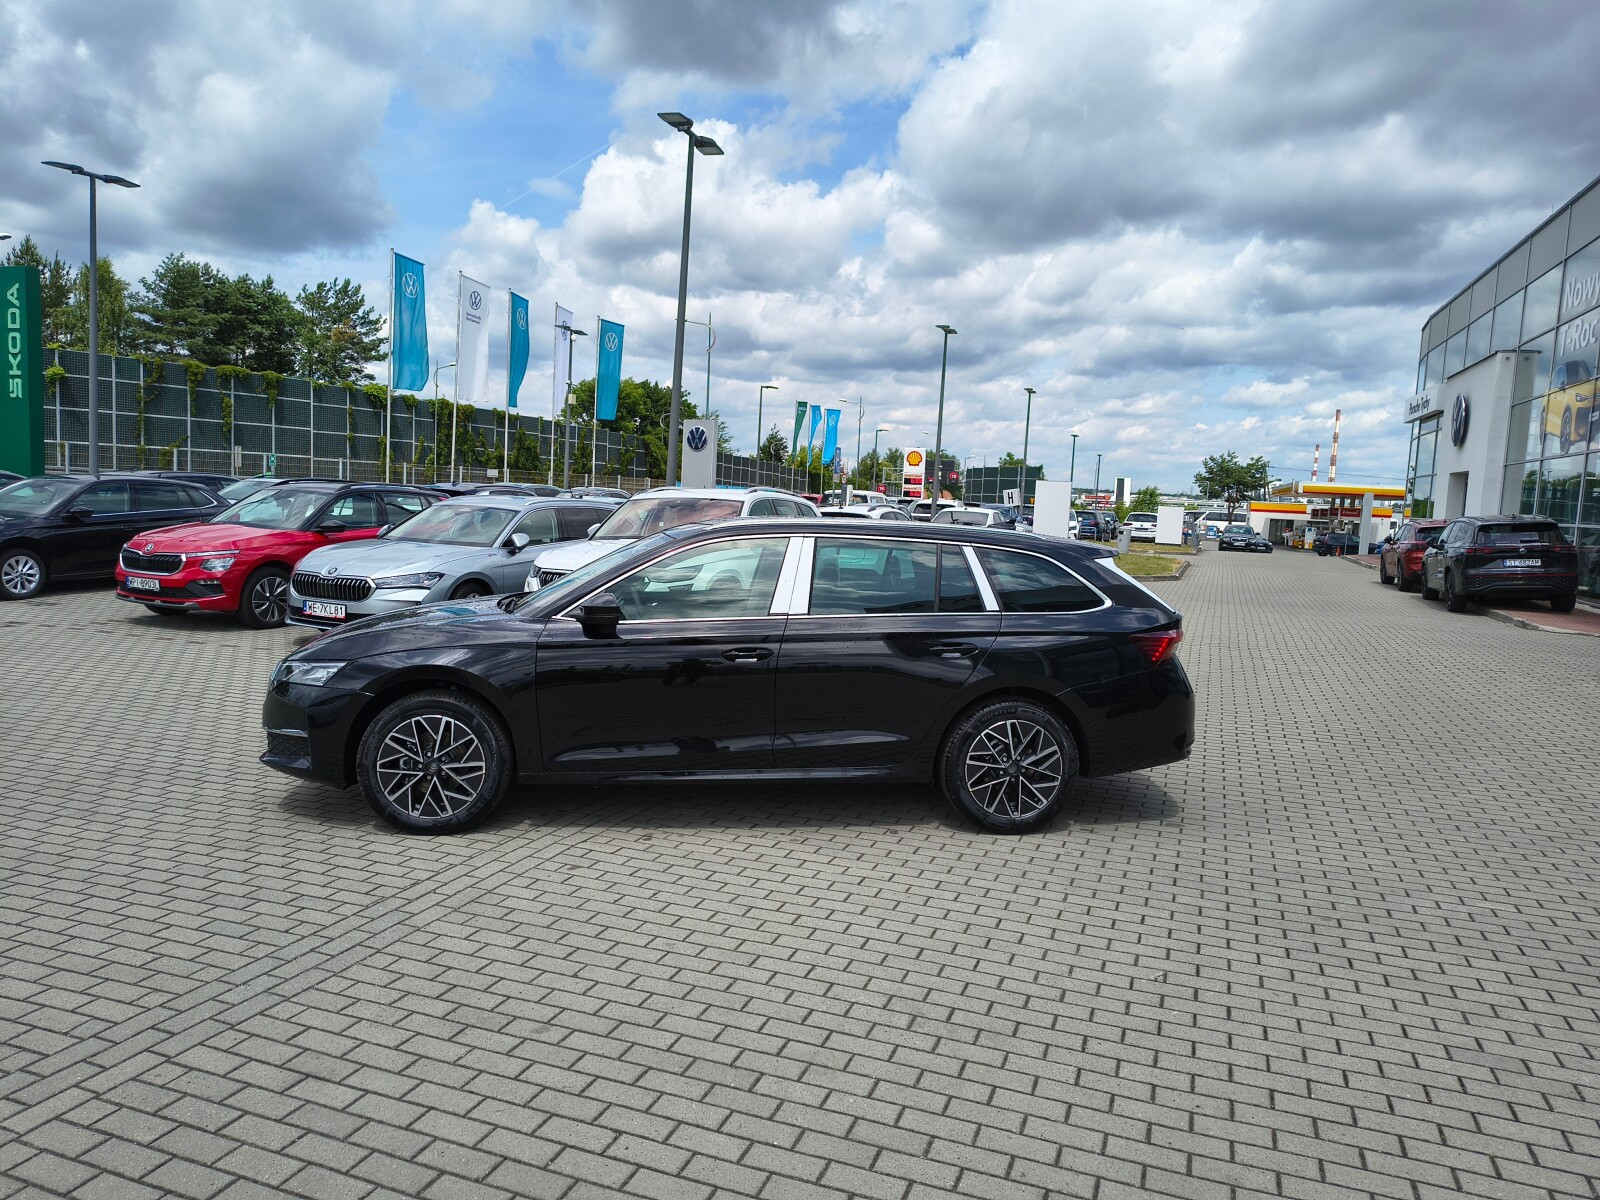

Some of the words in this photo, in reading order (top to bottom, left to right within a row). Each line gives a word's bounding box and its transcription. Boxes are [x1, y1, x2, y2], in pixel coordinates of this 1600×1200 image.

[1563, 272, 1600, 312] Nowy
[1560, 318, 1599, 357] T-Roc
[1007, 491, 1014, 504] H
